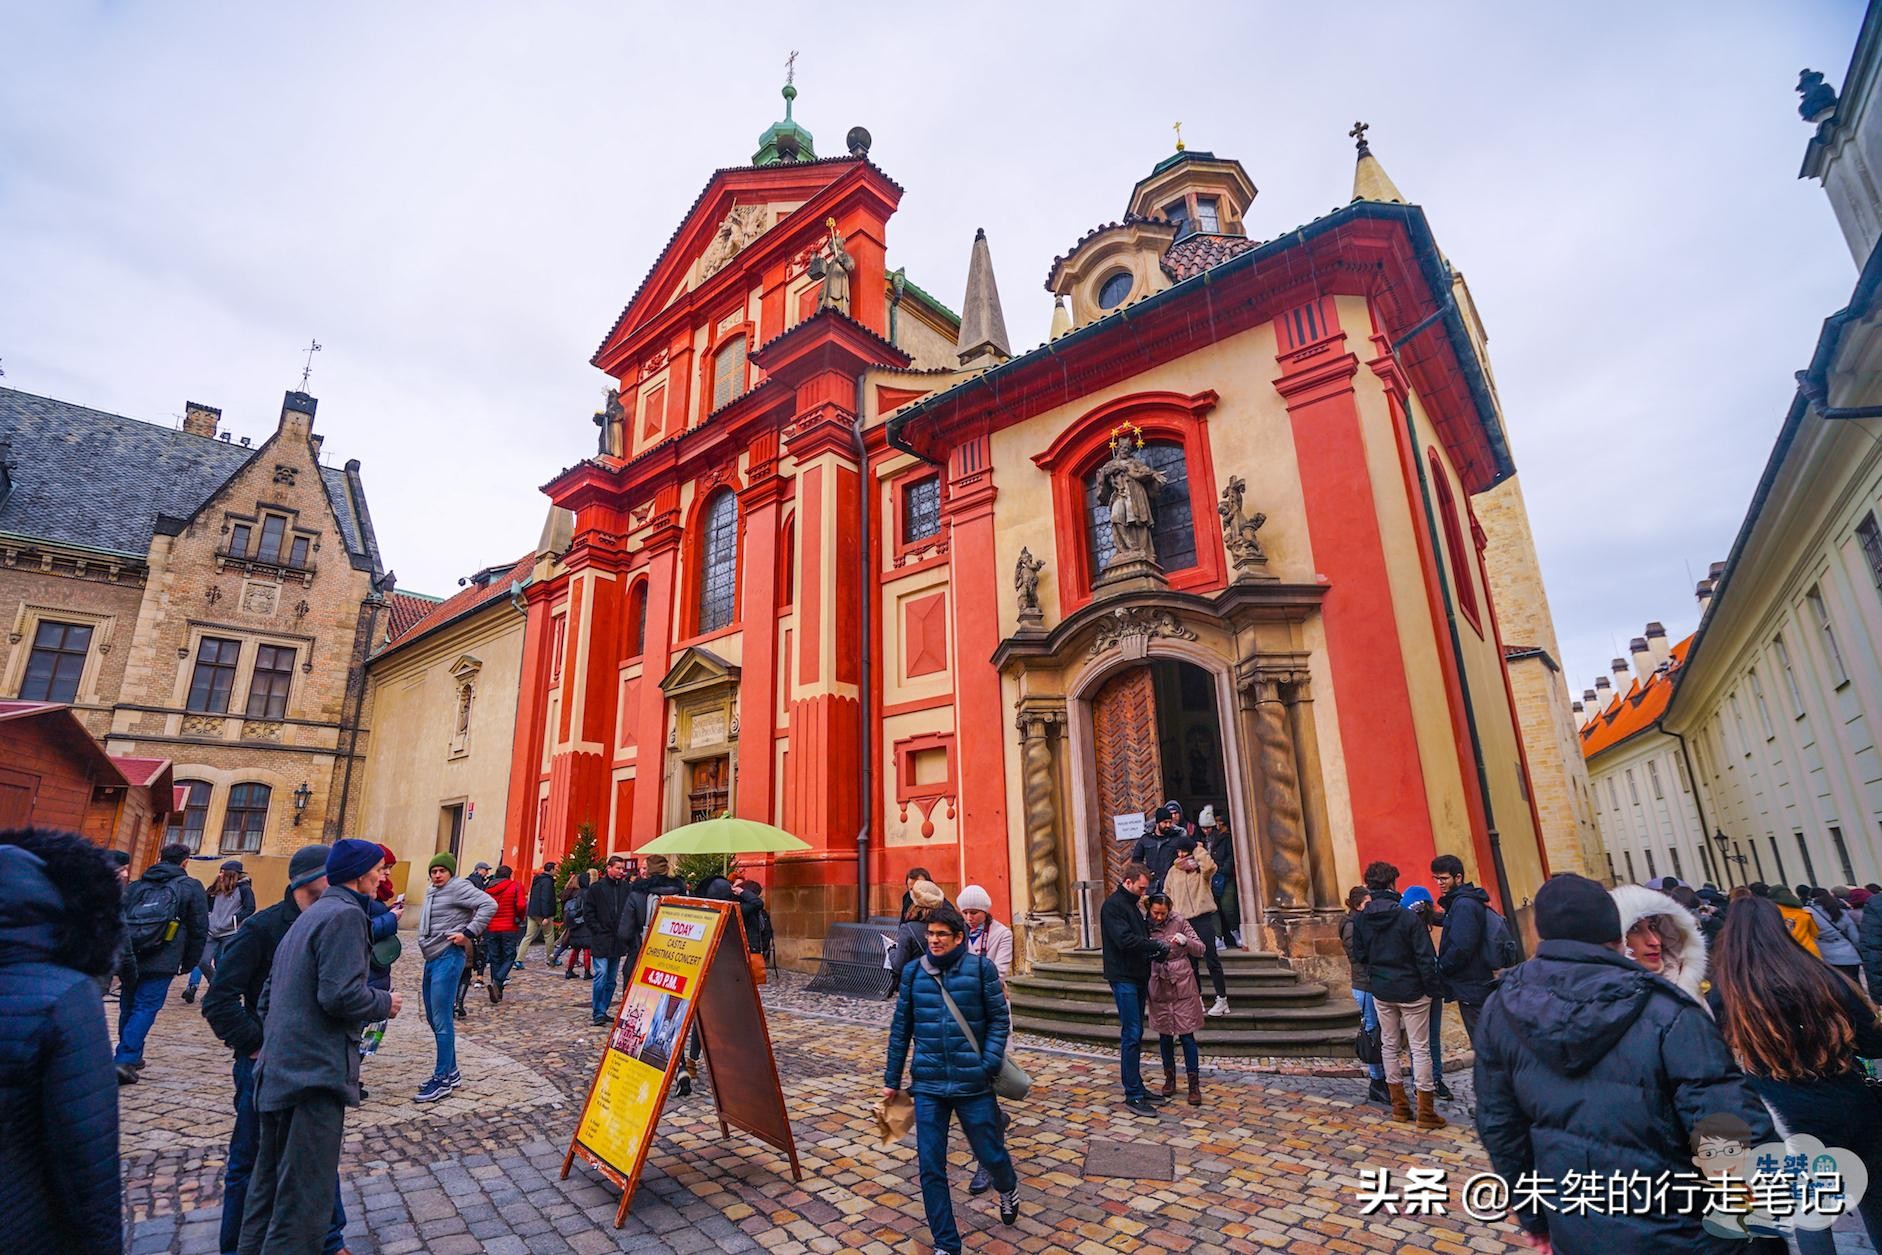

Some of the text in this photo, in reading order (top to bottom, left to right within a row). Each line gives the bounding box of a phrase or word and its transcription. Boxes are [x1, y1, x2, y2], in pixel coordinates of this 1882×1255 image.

[670, 922, 694, 936] TODAY
[667, 938, 687, 950] CASTLE
[646, 947, 701, 966] CHRISTMAS CONCERT
[647, 970, 663, 985] 4.30
